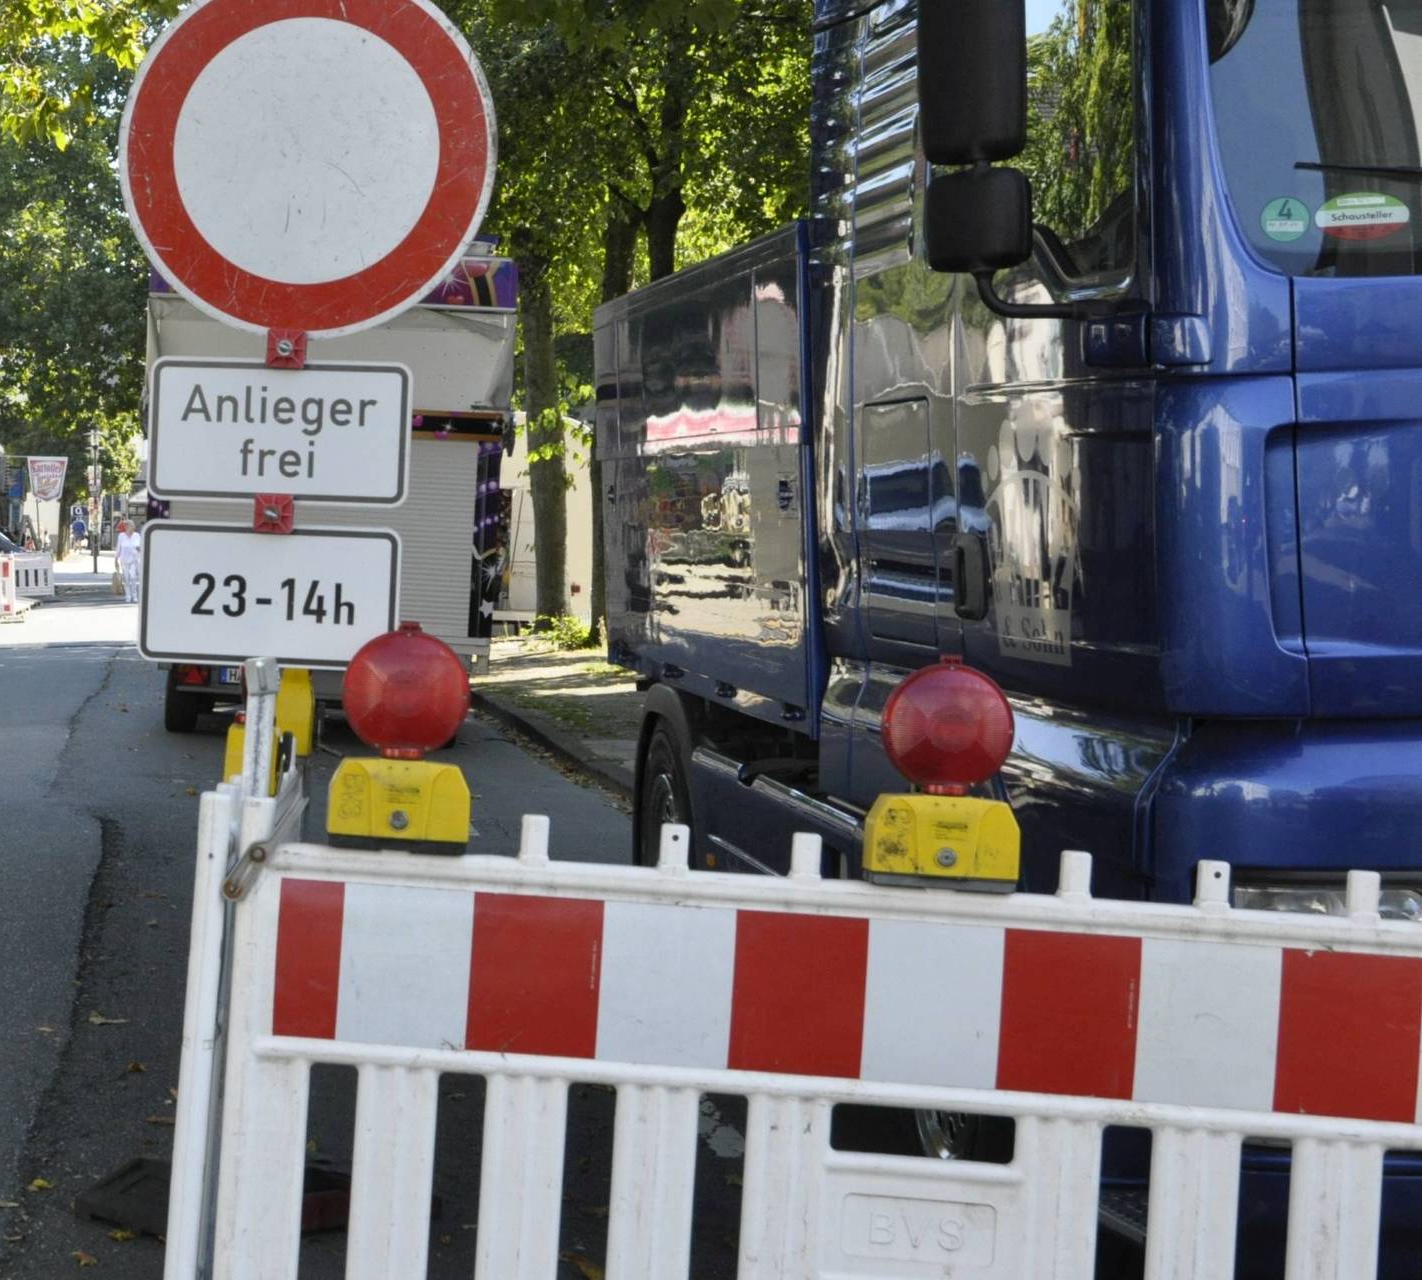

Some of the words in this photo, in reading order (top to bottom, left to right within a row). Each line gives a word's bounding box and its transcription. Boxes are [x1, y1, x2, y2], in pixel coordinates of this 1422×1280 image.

[1278, 200, 1293, 220] 4
[1330, 210, 1394, 222] Schausteller
[181, 383, 378, 437] Anlieger
[239, 438, 315, 479] frei
[190, 572, 355, 627] 23-14h
[1020, 616, 1065, 656] Sohn
[868, 1211, 964, 1252] BVS
